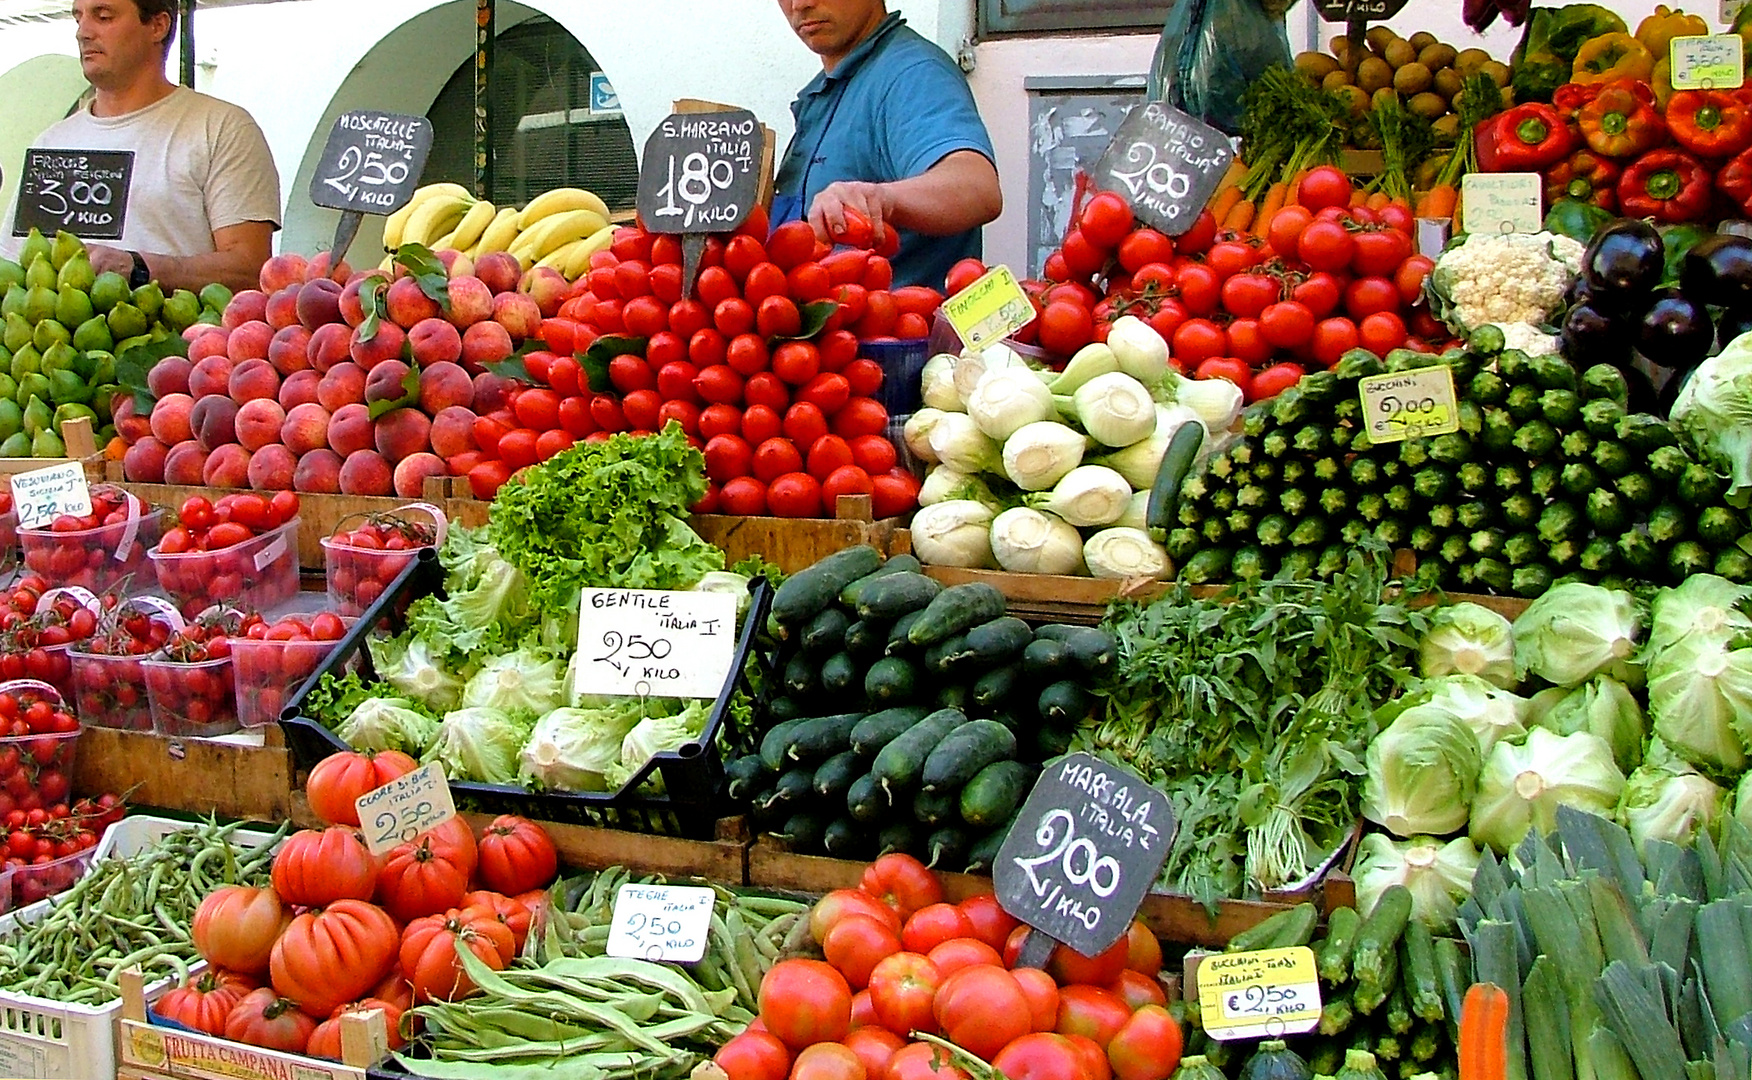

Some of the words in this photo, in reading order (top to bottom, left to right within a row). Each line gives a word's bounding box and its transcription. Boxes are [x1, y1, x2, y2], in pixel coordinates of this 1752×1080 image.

[592, 592, 670, 609] GENTILE
[1059, 762, 1152, 829] MARSALA
[164, 1035, 217, 1061] FRUTTA
[219, 1047, 289, 1080] CAMPANA
